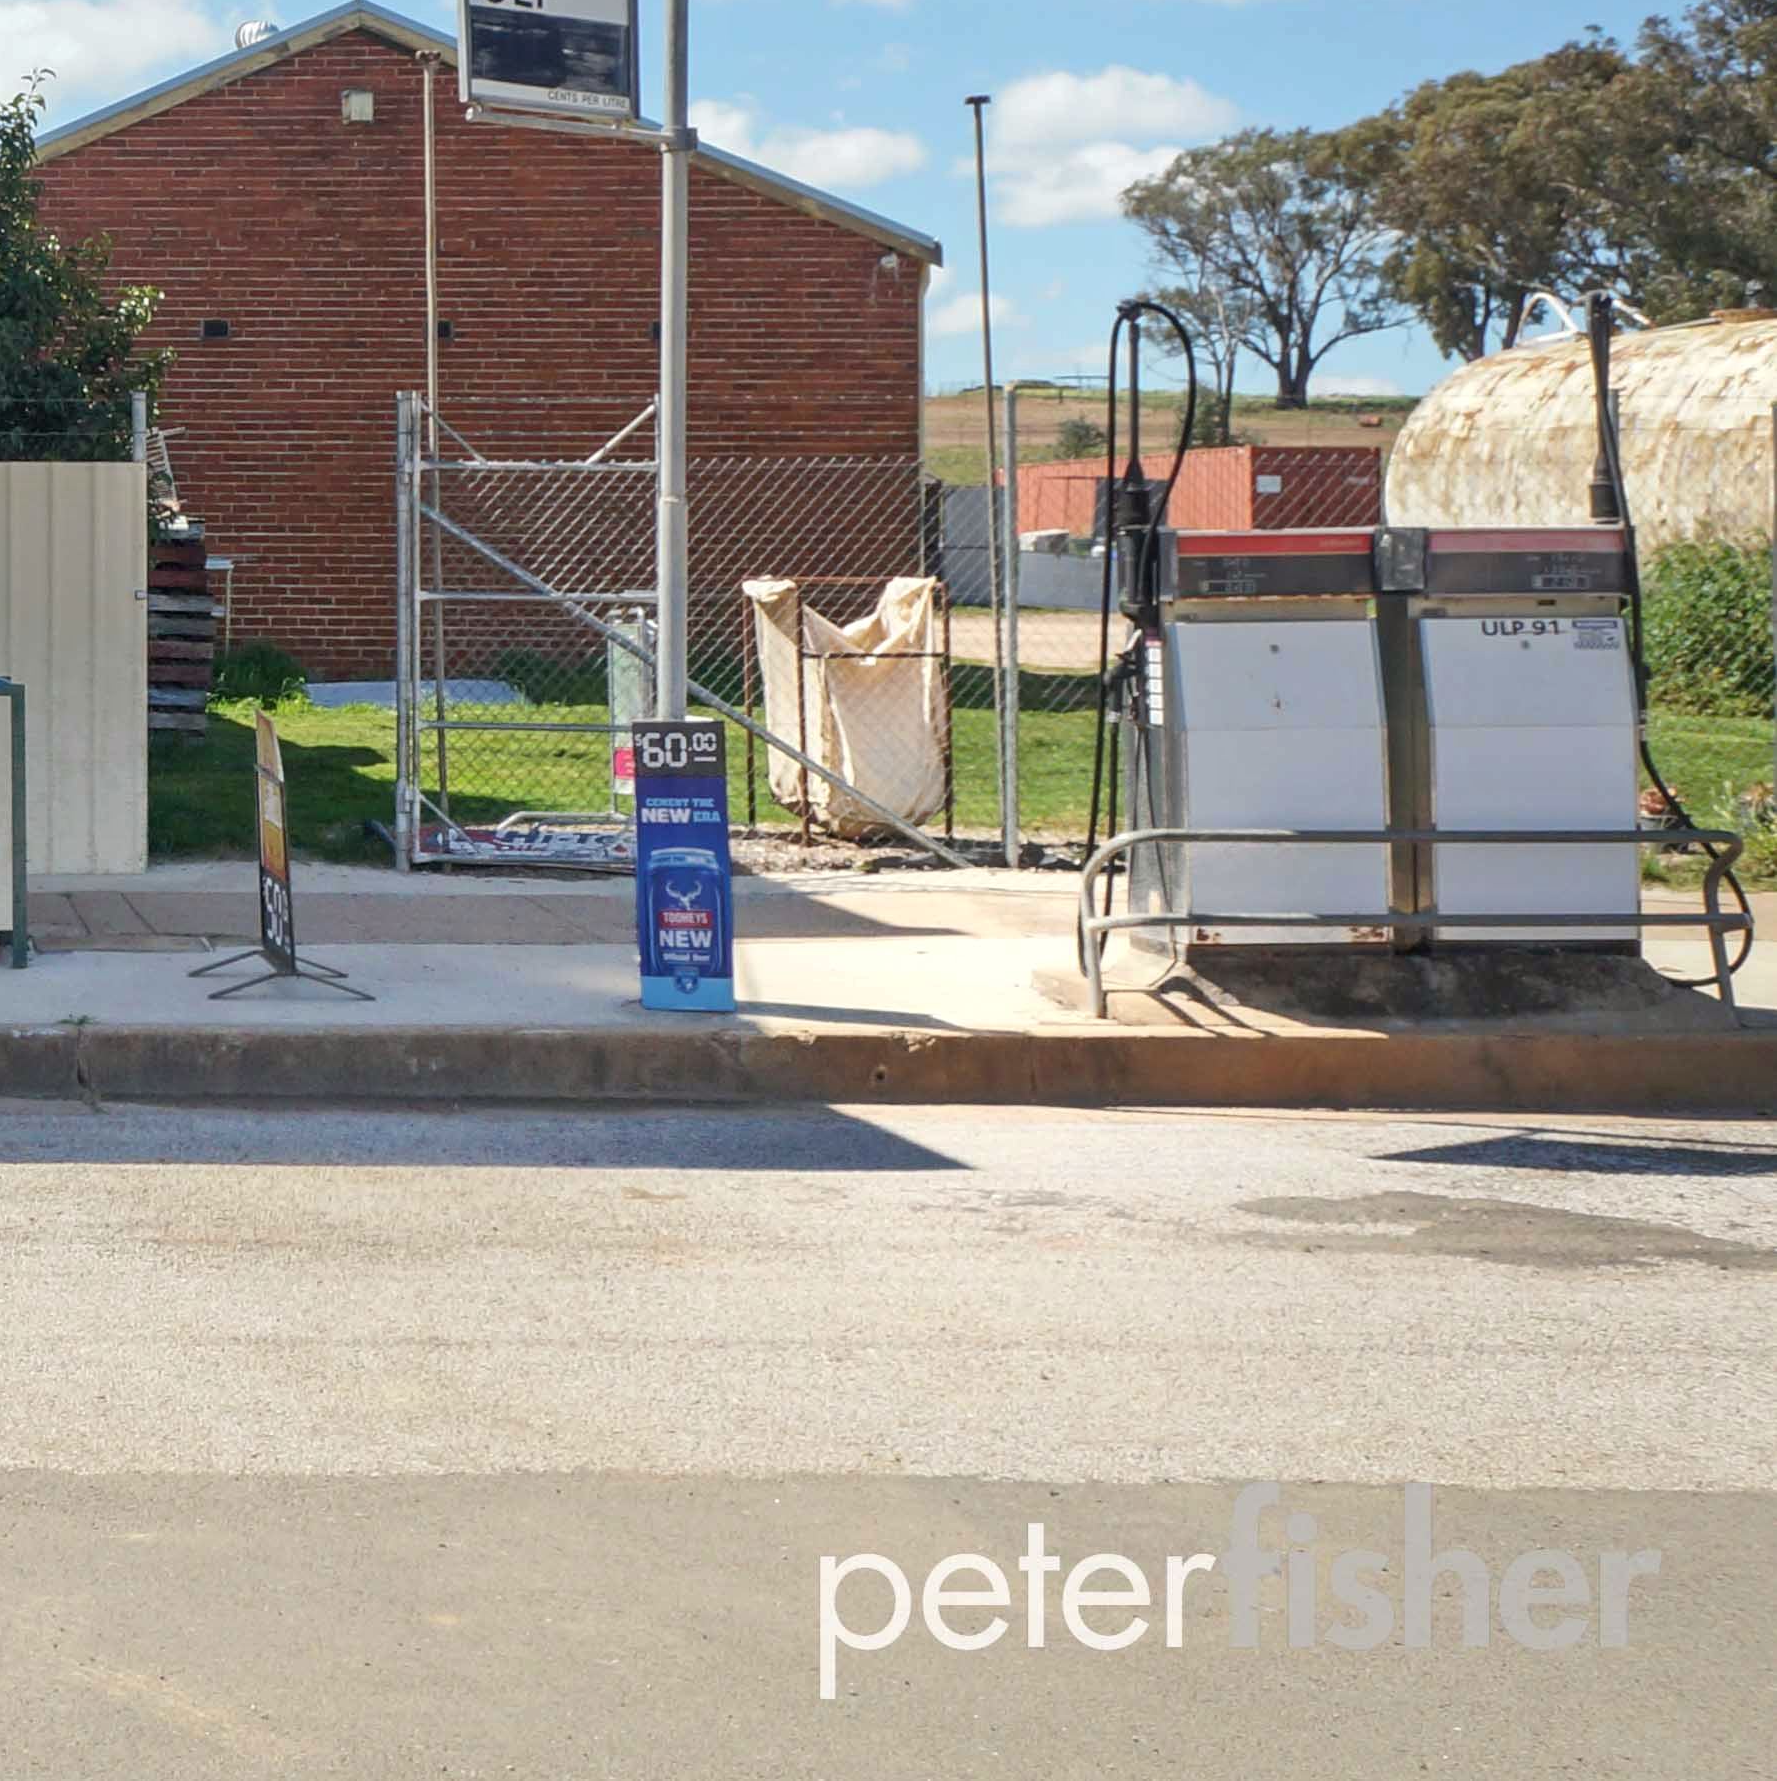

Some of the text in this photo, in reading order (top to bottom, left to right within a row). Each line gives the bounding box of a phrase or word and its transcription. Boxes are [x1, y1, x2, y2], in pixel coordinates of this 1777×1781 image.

[547, 90, 627, 108] CENTS PER LITRE
[1481, 620, 1524, 636] ULP
[1532, 620, 1560, 636] 91
[641, 807, 692, 823] NEW
[659, 930, 713, 948] NEW
